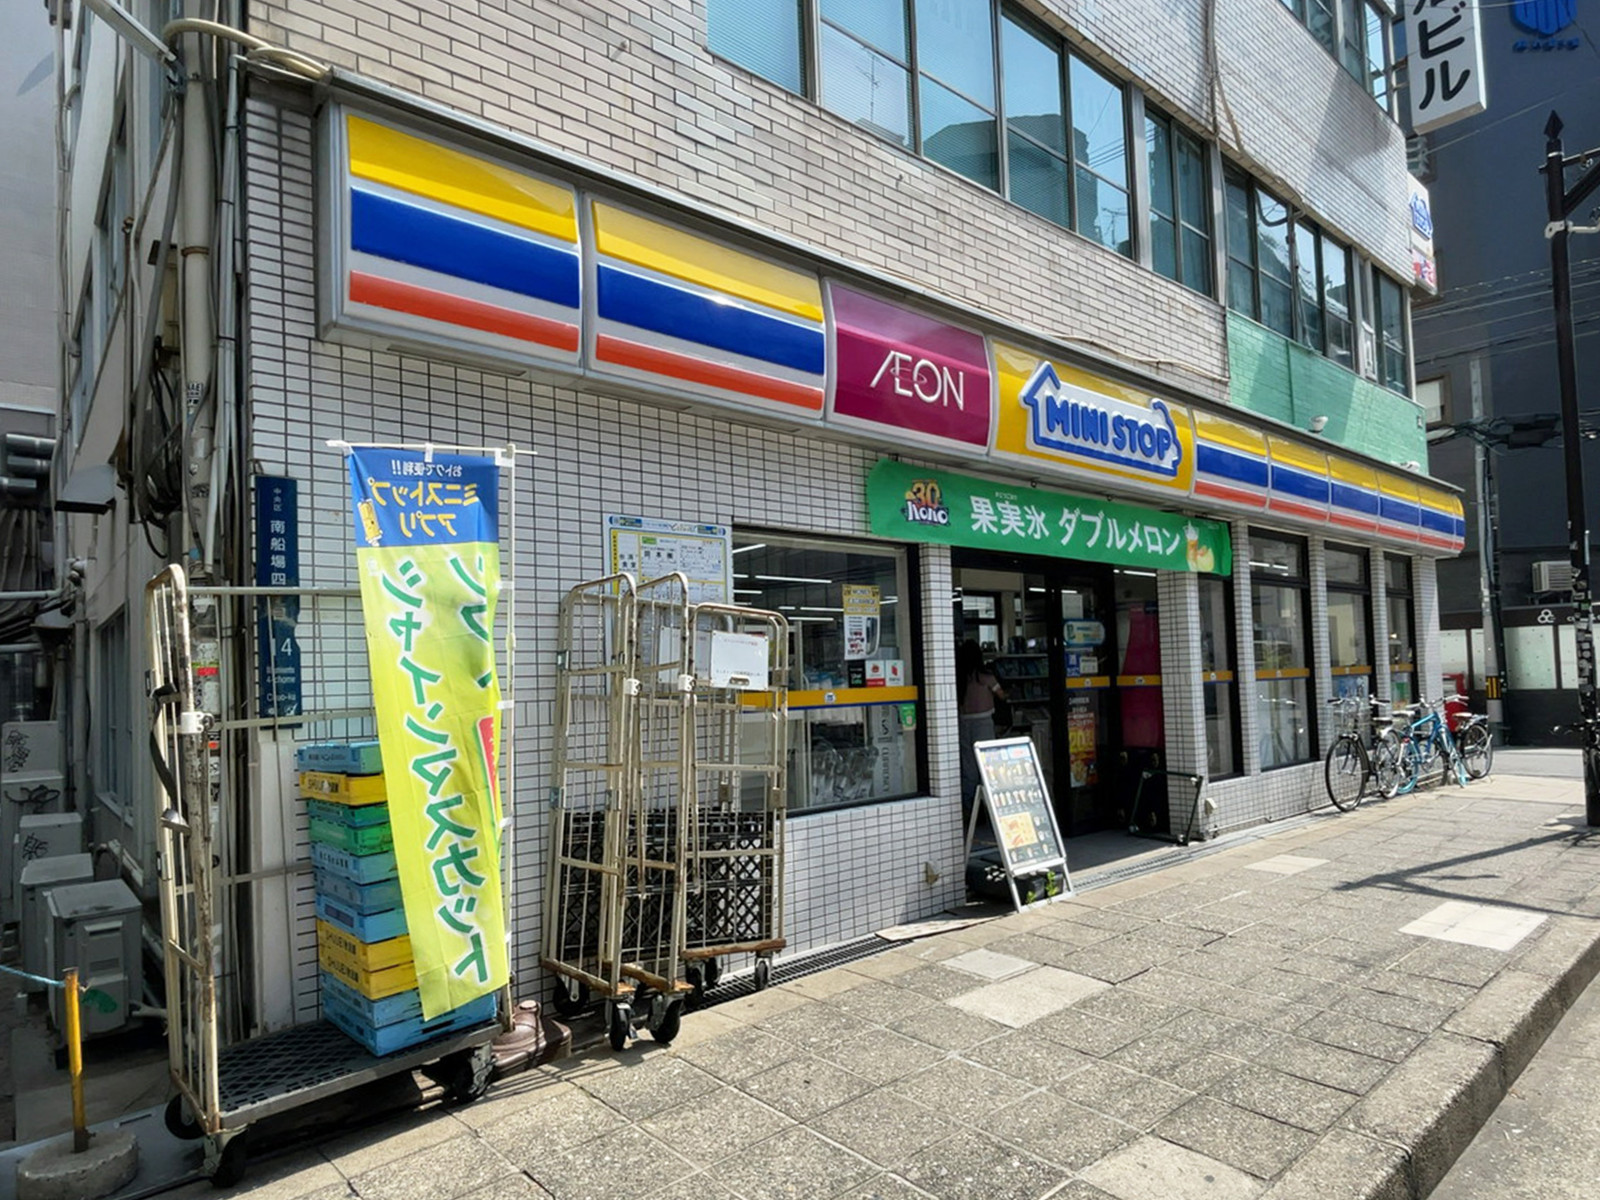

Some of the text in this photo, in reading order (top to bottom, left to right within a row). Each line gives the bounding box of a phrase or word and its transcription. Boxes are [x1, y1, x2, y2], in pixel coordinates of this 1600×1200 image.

[1045, 391, 1172, 461] MINI STOP
[970, 495, 1181, 556] 果実氷 ダブルメロン
